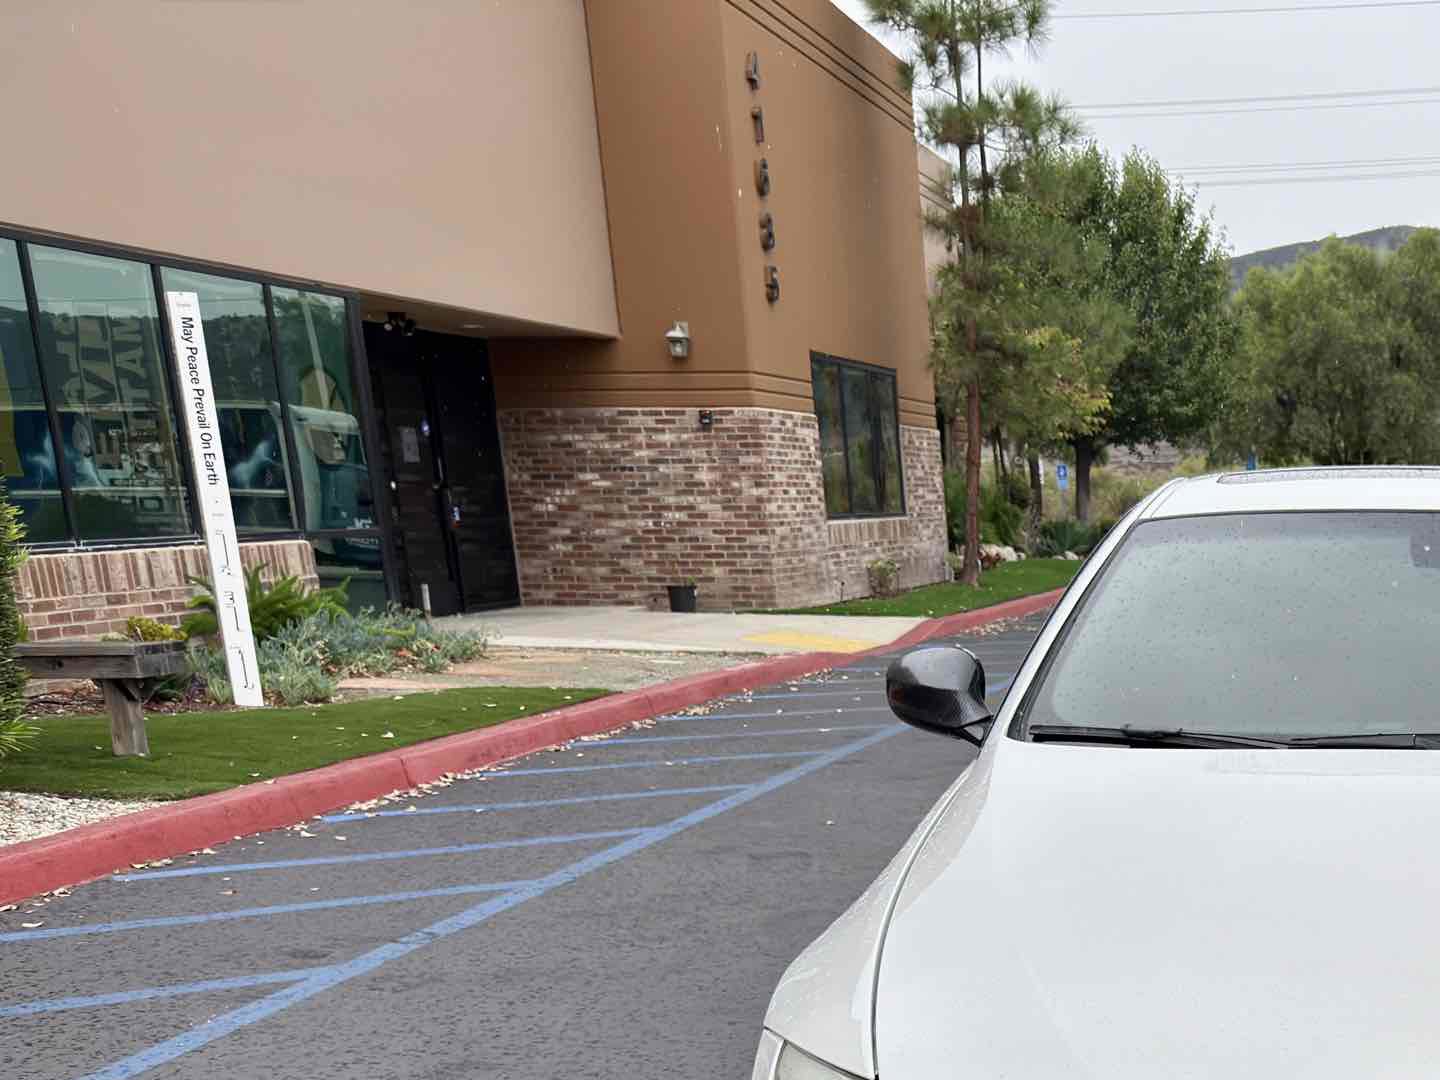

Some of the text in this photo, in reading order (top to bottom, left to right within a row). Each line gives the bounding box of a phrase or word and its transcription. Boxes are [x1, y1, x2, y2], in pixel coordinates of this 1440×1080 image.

[180, 316, 221, 486] May Peace Prevail On Earth
